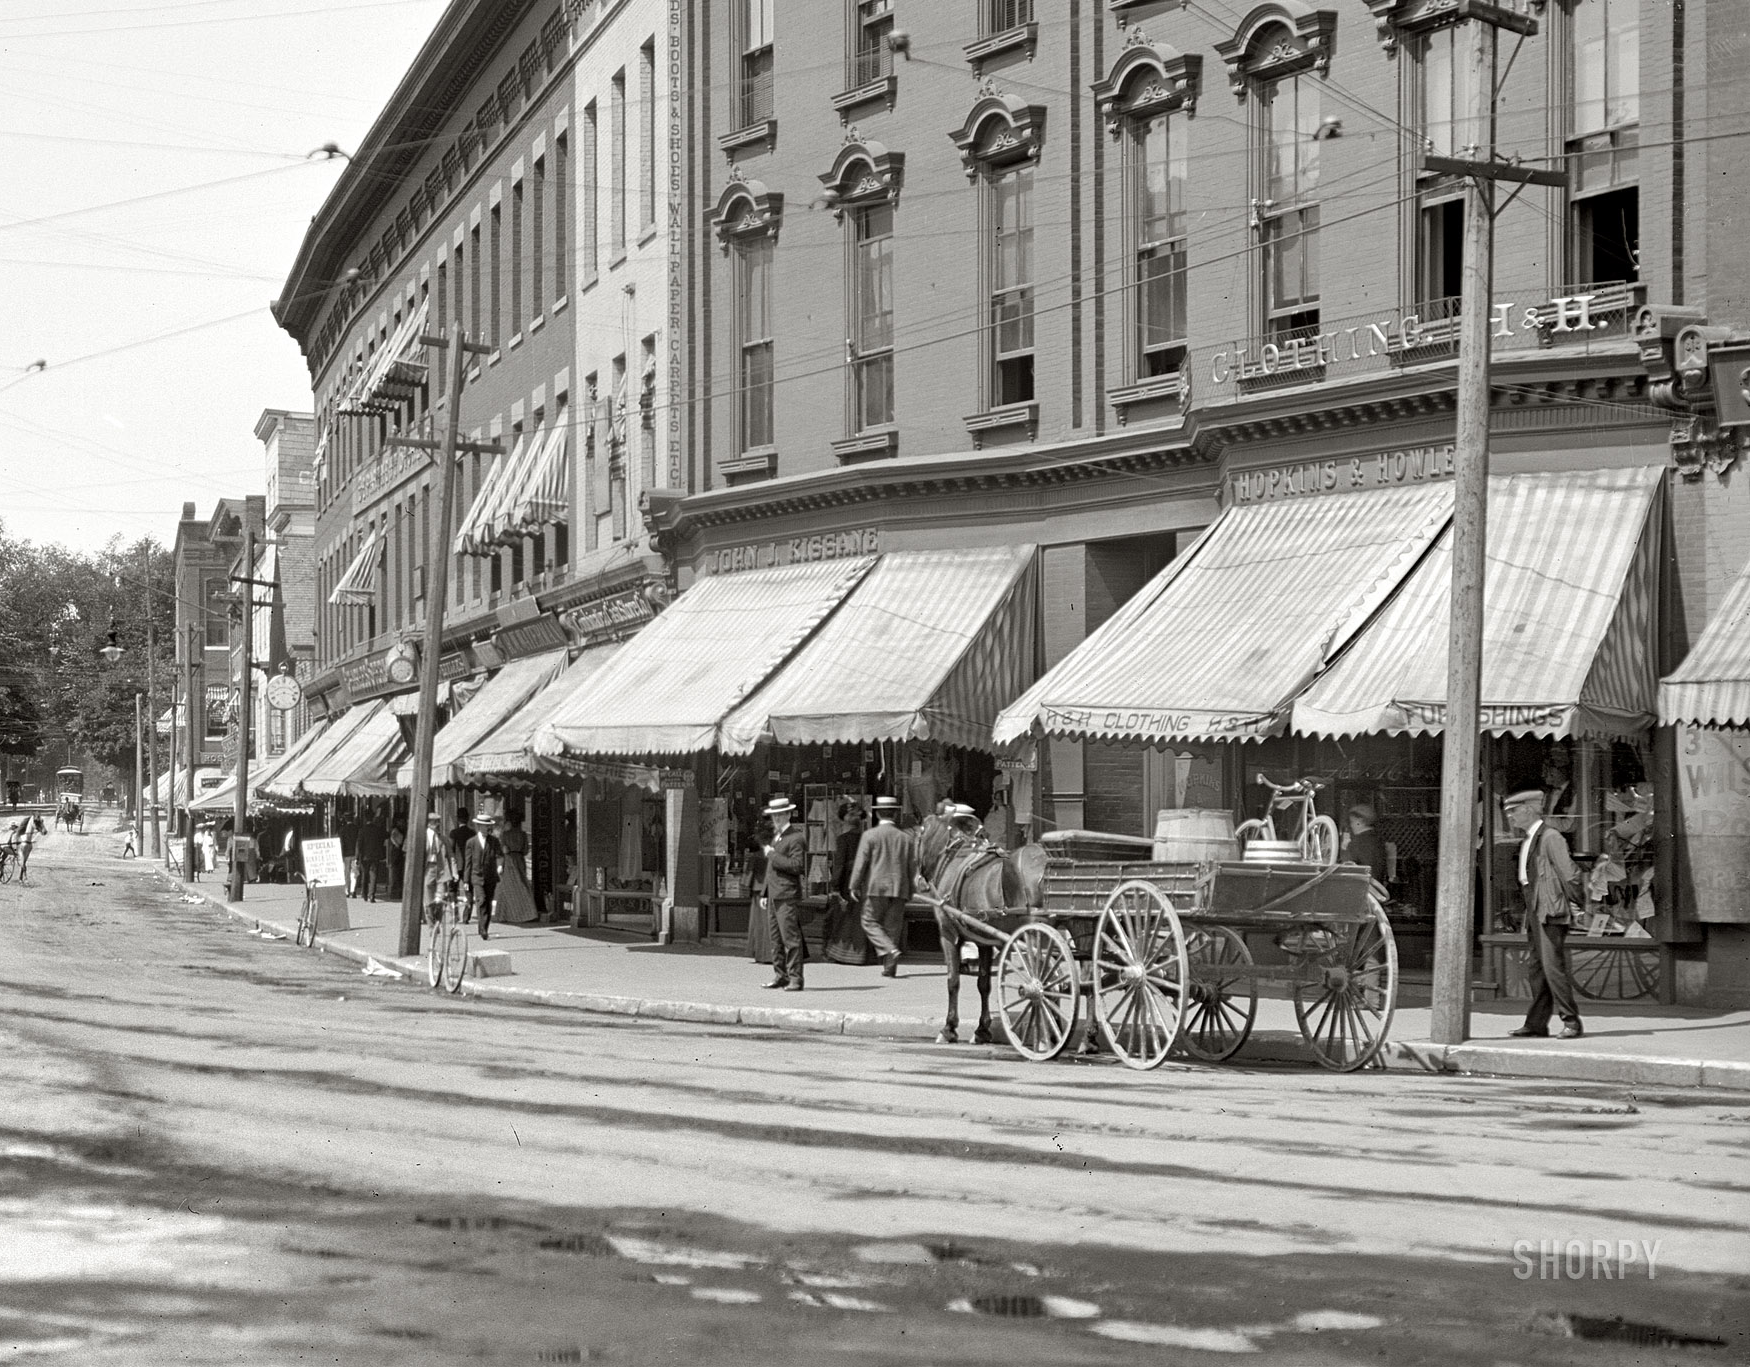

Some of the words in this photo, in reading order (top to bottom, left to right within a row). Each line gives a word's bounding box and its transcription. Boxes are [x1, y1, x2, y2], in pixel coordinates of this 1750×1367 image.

[669, 35, 680, 102] BOOTS
[669, 123, 681, 191] SHOES
[669, 203, 681, 255] WALL
[670, 261, 680, 329] PAPER
[1211, 314, 1434, 383] CLOTHING.
[670, 339, 680, 432] CARPETS
[1240, 459, 1337, 502] HOPKINS
[1351, 456, 1364, 485] &
[1377, 445, 1456, 483] HOWLE
[710, 545, 759, 574] JOHN
[766, 543, 780, 566] J.
[788, 528, 880, 564] KISSANE
[1103, 712, 1192, 732] CLOTHING
